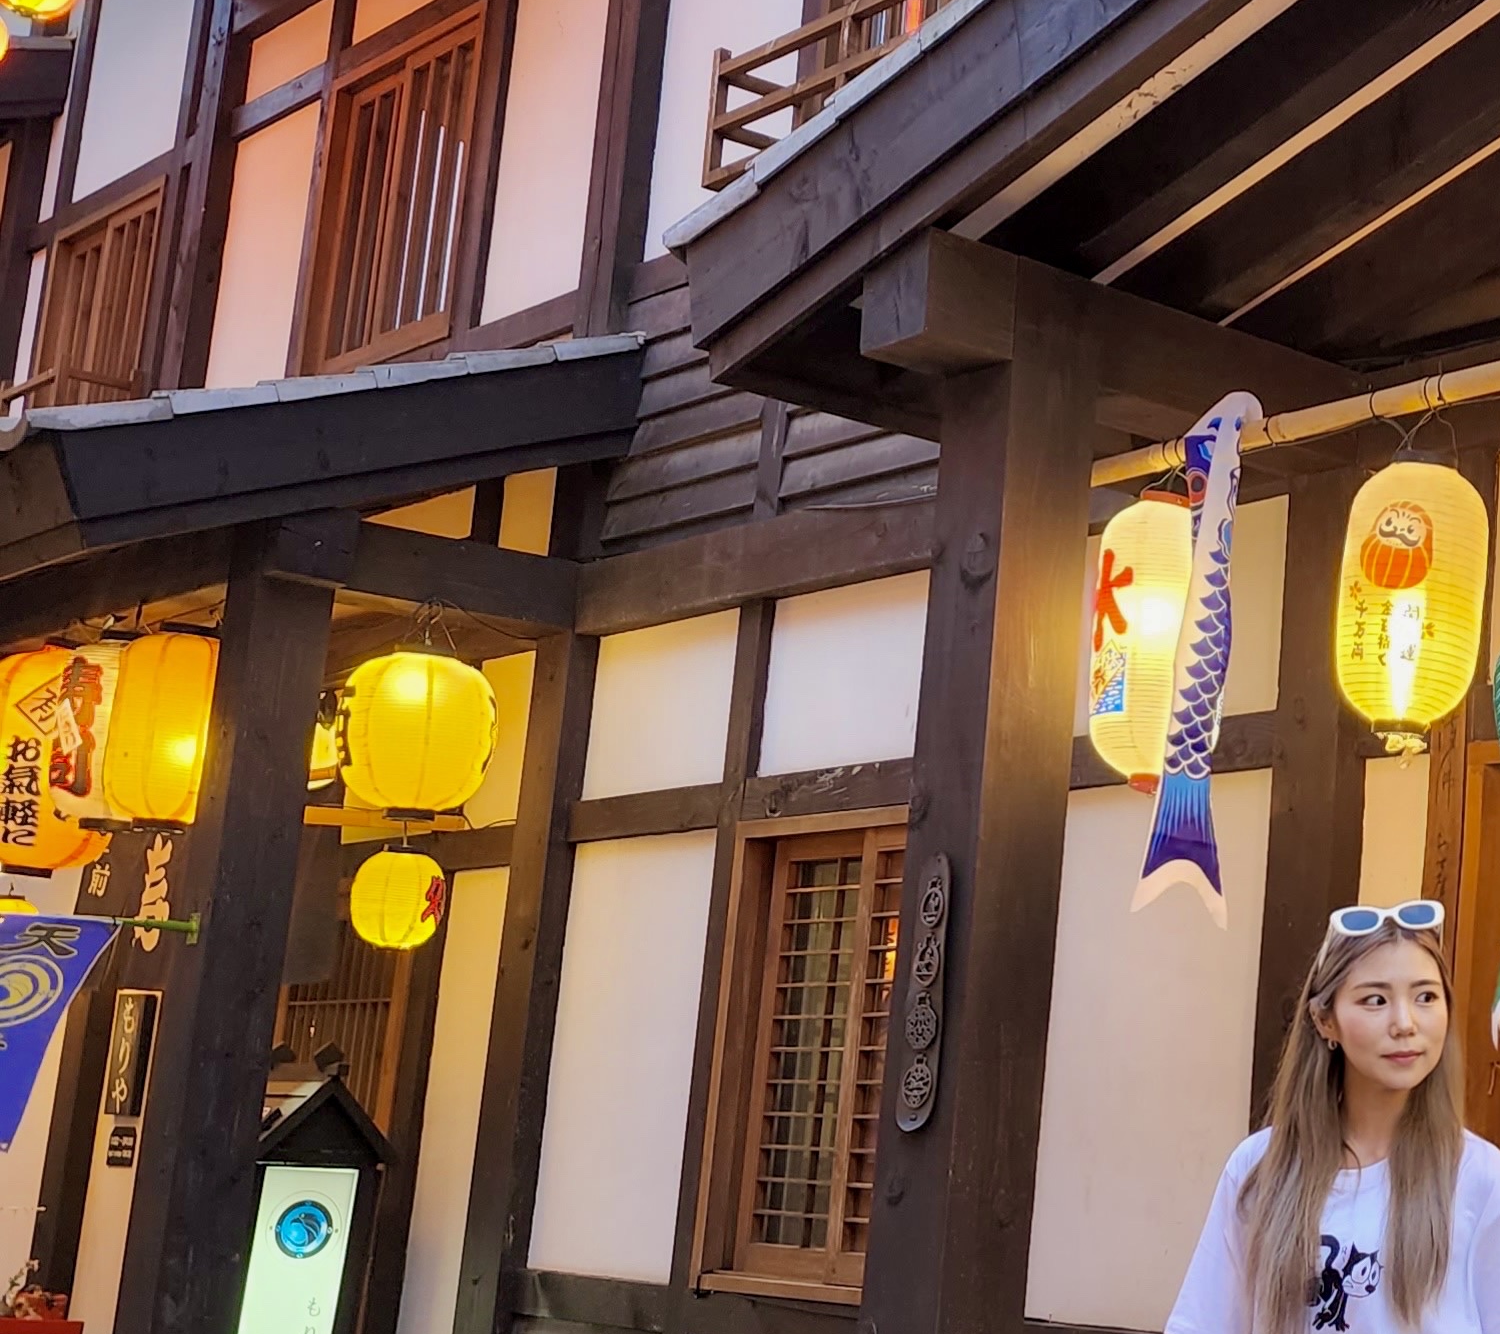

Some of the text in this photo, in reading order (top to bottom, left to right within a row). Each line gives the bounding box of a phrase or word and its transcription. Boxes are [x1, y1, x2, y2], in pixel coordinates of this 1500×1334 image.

[0, 733, 42, 847] お気軽に
[111, 996, 136, 1115] もりや
